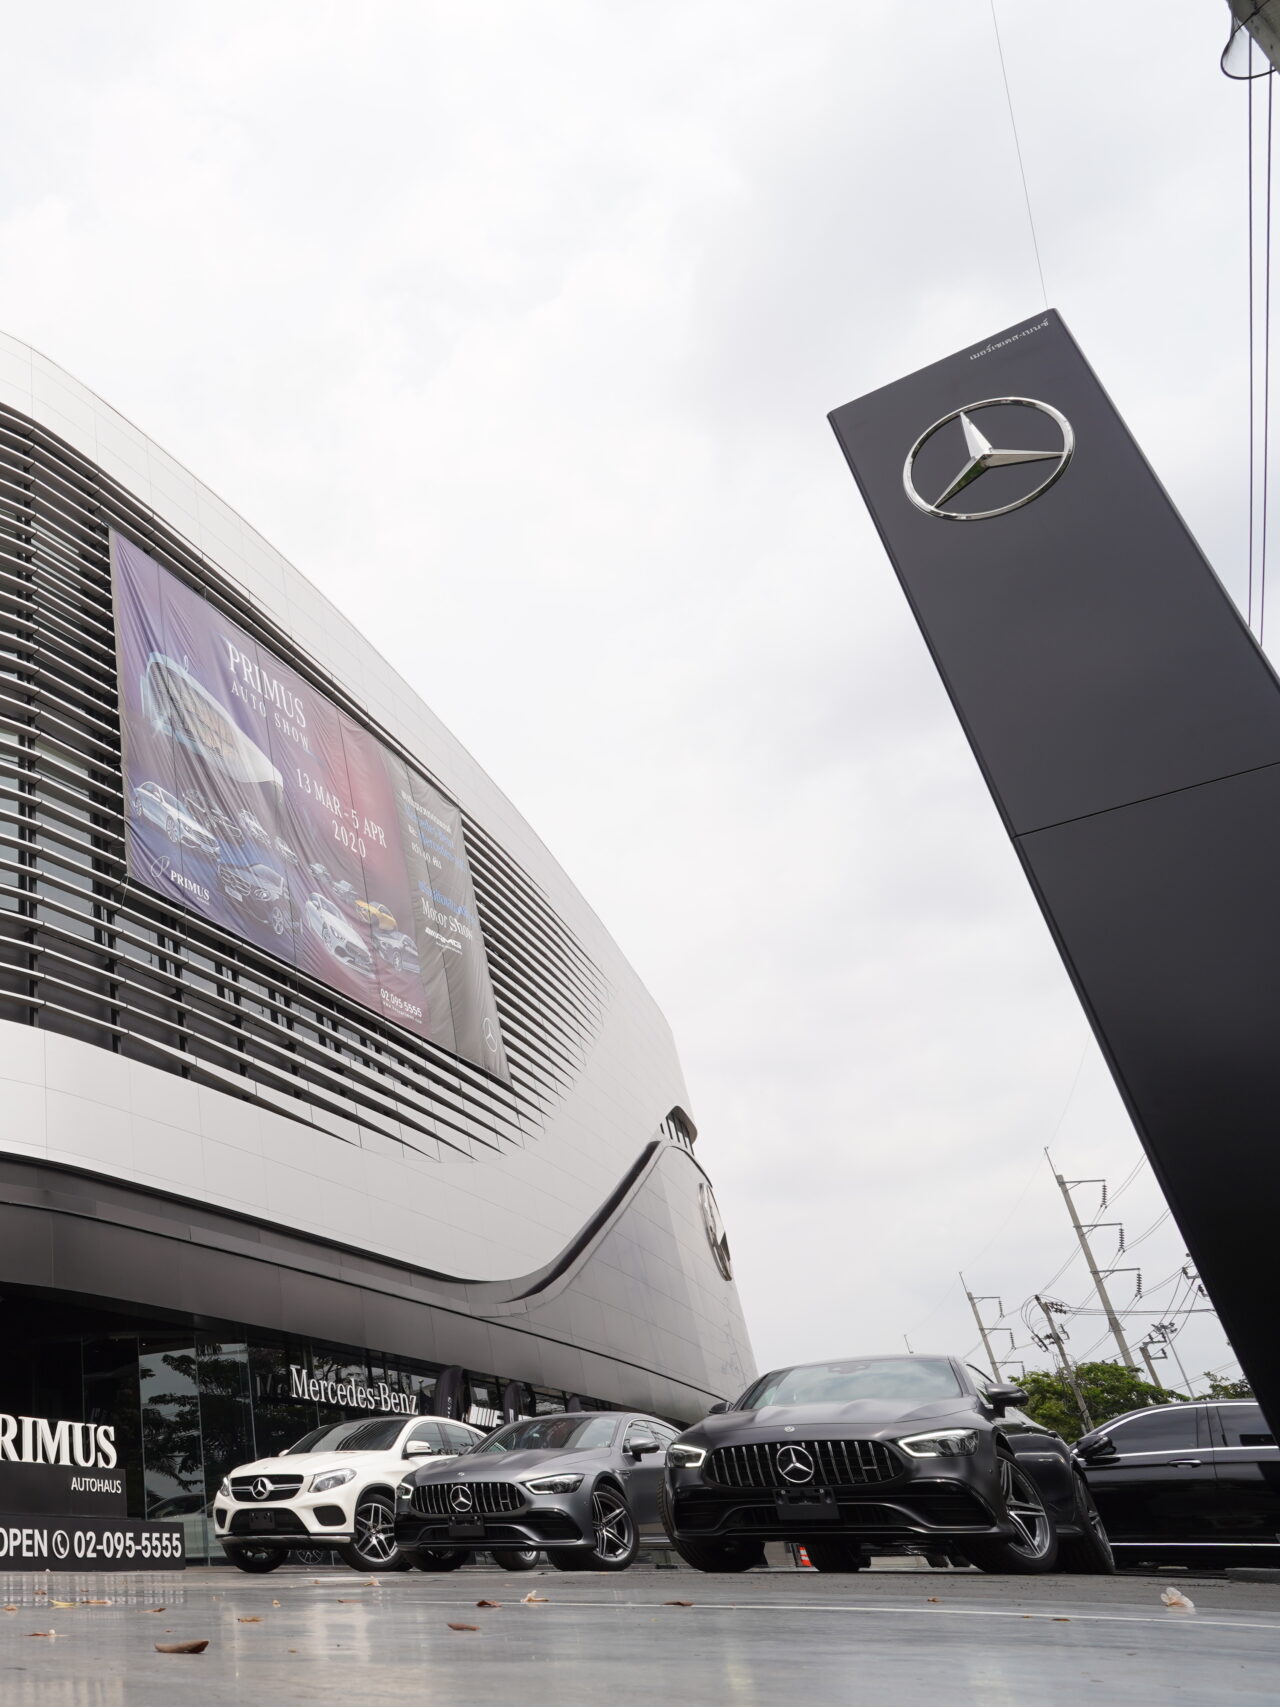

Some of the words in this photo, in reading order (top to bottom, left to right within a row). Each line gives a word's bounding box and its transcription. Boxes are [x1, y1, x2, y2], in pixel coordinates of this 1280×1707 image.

[226, 640, 307, 728] PRIMUS
[231, 682, 267, 718] AUTO
[273, 713, 310, 749] SHOW
[296, 768, 312, 794] 13
[314, 780, 345, 819] MAR
[351, 809, 359, 830] 5
[363, 816, 387, 849] APR
[332, 819, 366, 858] 2020
[170, 869, 210, 901] PRIMUS
[421, 896, 448, 929] Motor
[380, 988, 390, 1002] 02
[403, 1001, 423, 1018] 5555
[289, 1364, 419, 1415] Mercedes-Benz
[70, 1477, 122, 1494] AUTOHAUS
[73, 1530, 183, 1559] 02-095-5555
